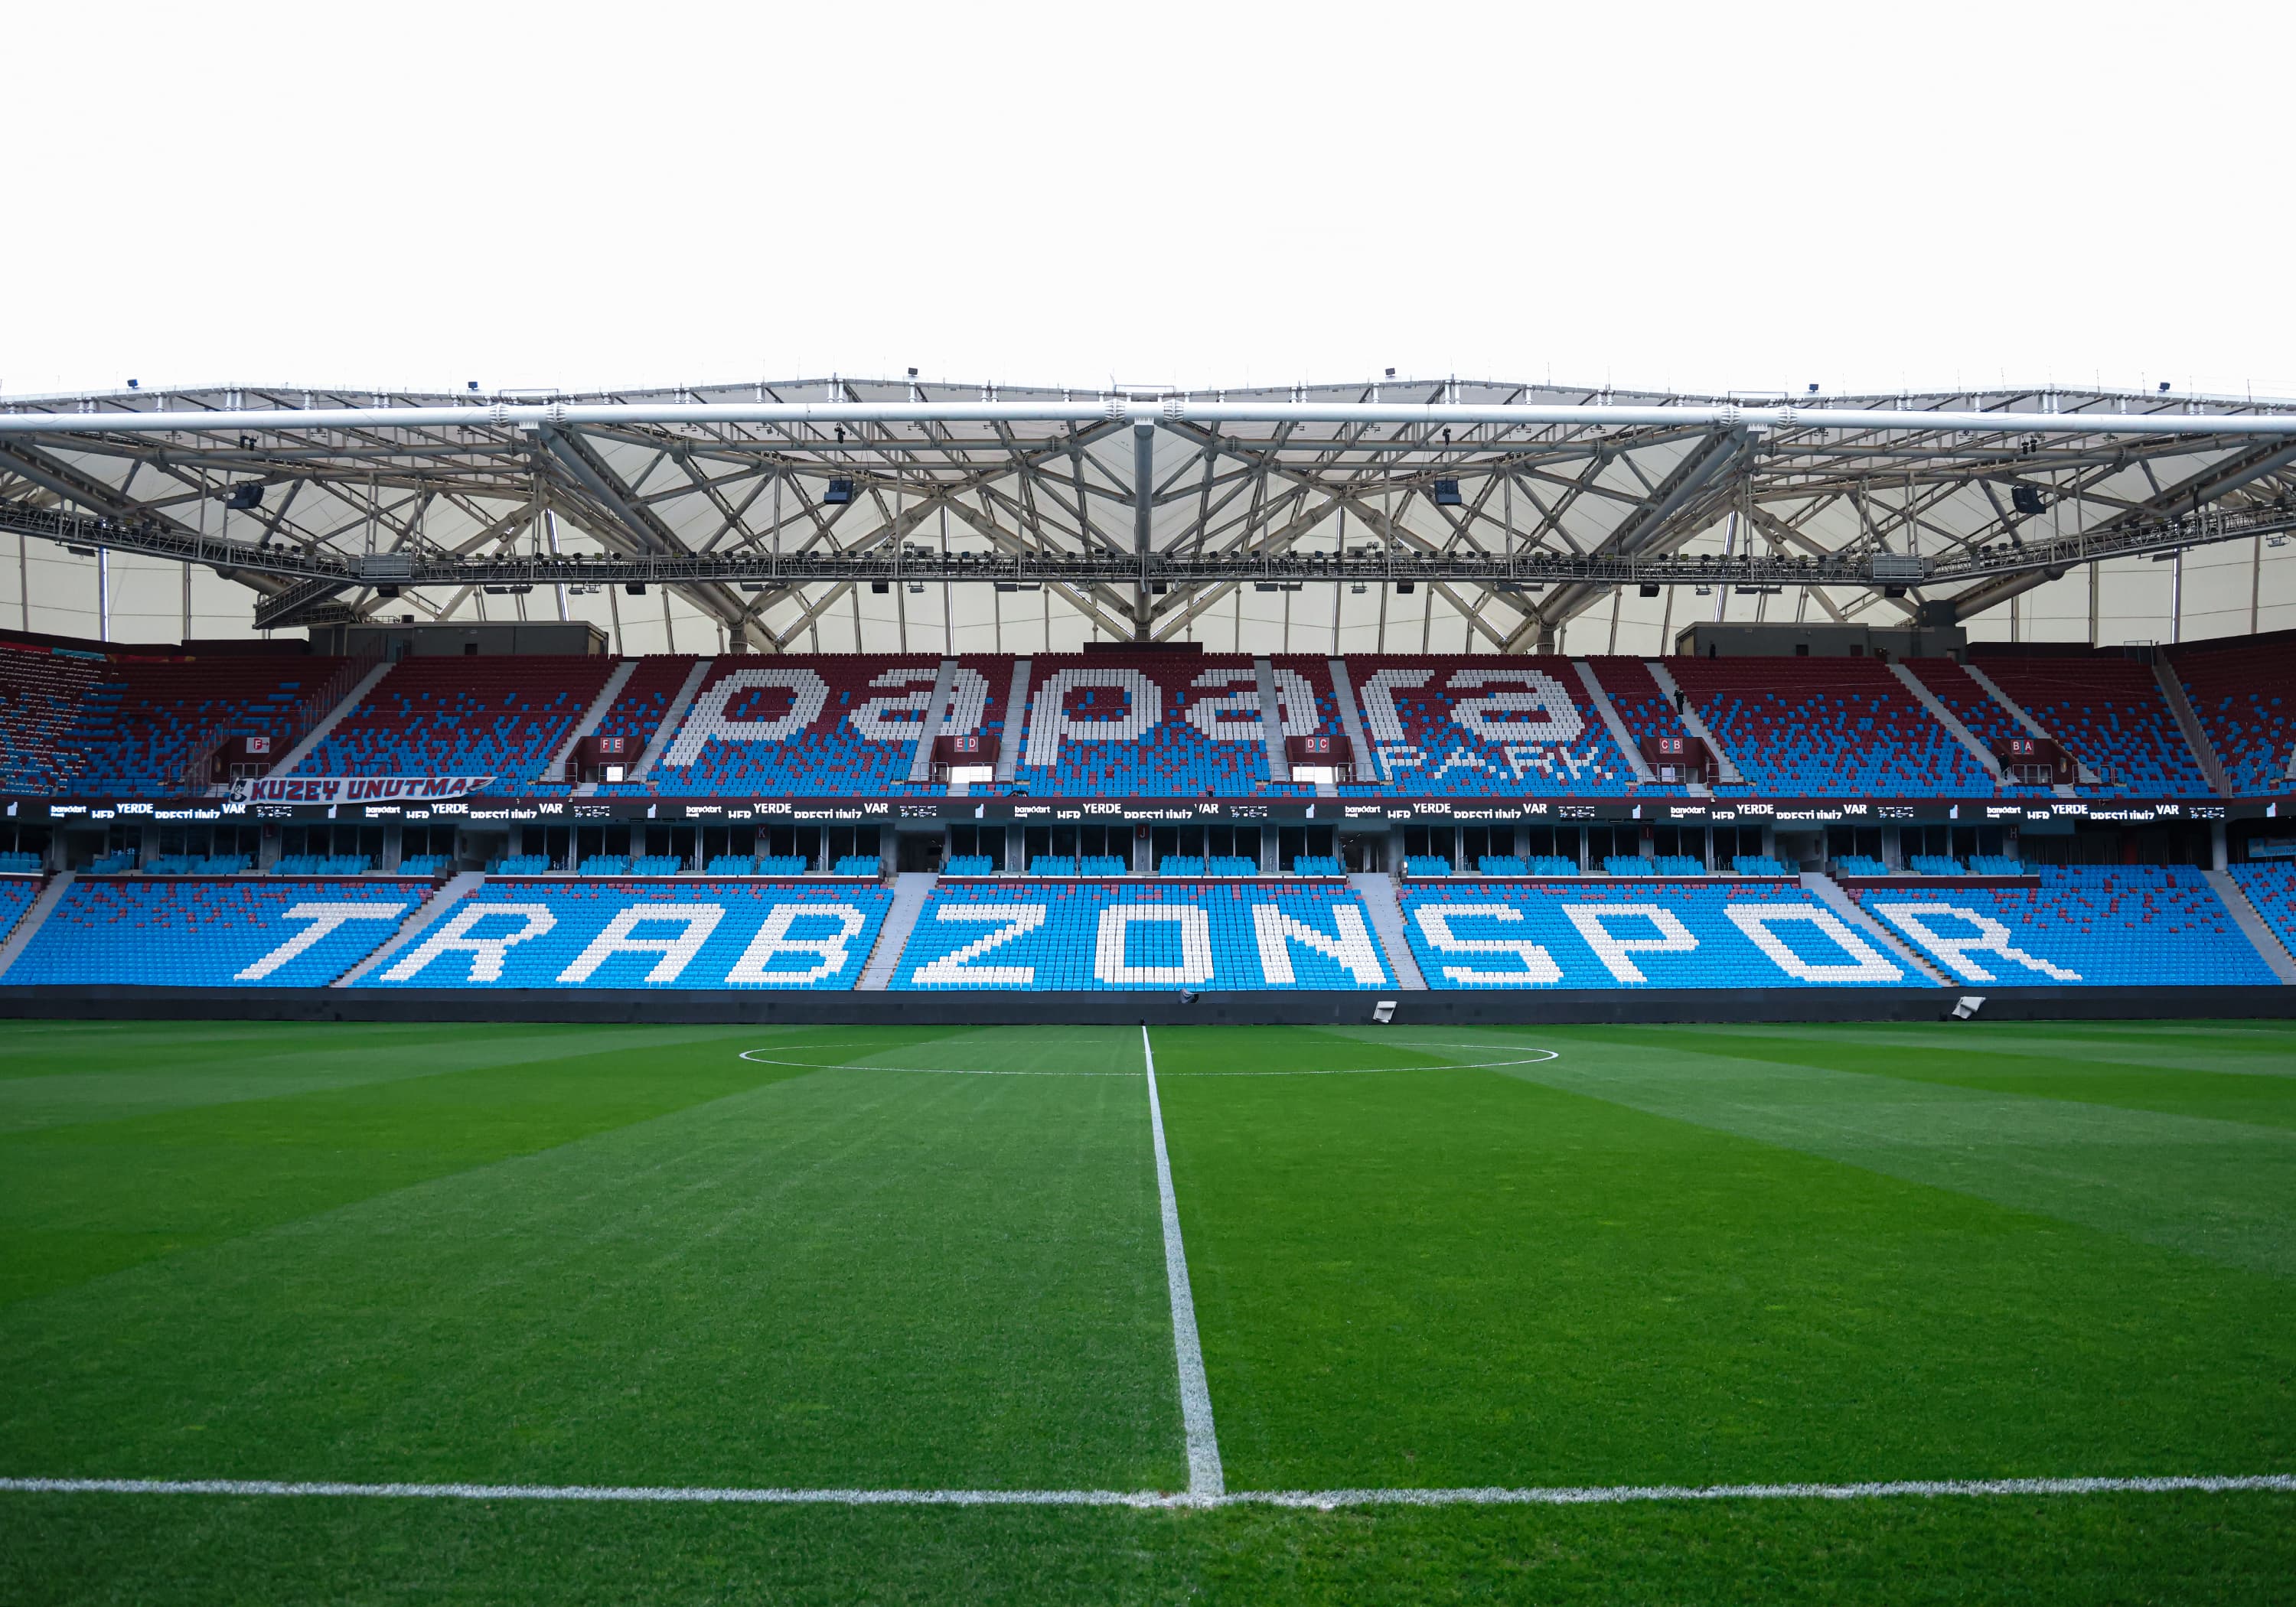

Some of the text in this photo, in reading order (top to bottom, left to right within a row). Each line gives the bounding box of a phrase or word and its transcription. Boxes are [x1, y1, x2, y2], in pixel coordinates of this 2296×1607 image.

[1377, 746, 1614, 780] PARK
[249, 779, 340, 802] KUZEY
[117, 804, 153, 813] YERDE
[223, 803, 245, 813] VAR
[432, 804, 468, 813] YERDE
[540, 803, 563, 813] VAR
[754, 804, 791, 813] YERDE
[865, 803, 888, 813] VAR
[1084, 804, 1121, 813] YERDE
[1414, 804, 1451, 813] YERDE
[1524, 803, 1547, 813] VAR
[1737, 804, 1774, 814] YERDE
[1844, 804, 1867, 814] VAR
[2051, 804, 2088, 814] YERDE
[2156, 804, 2179, 814] VAR
[233, 902, 2082, 983] TRABZONSPOR
